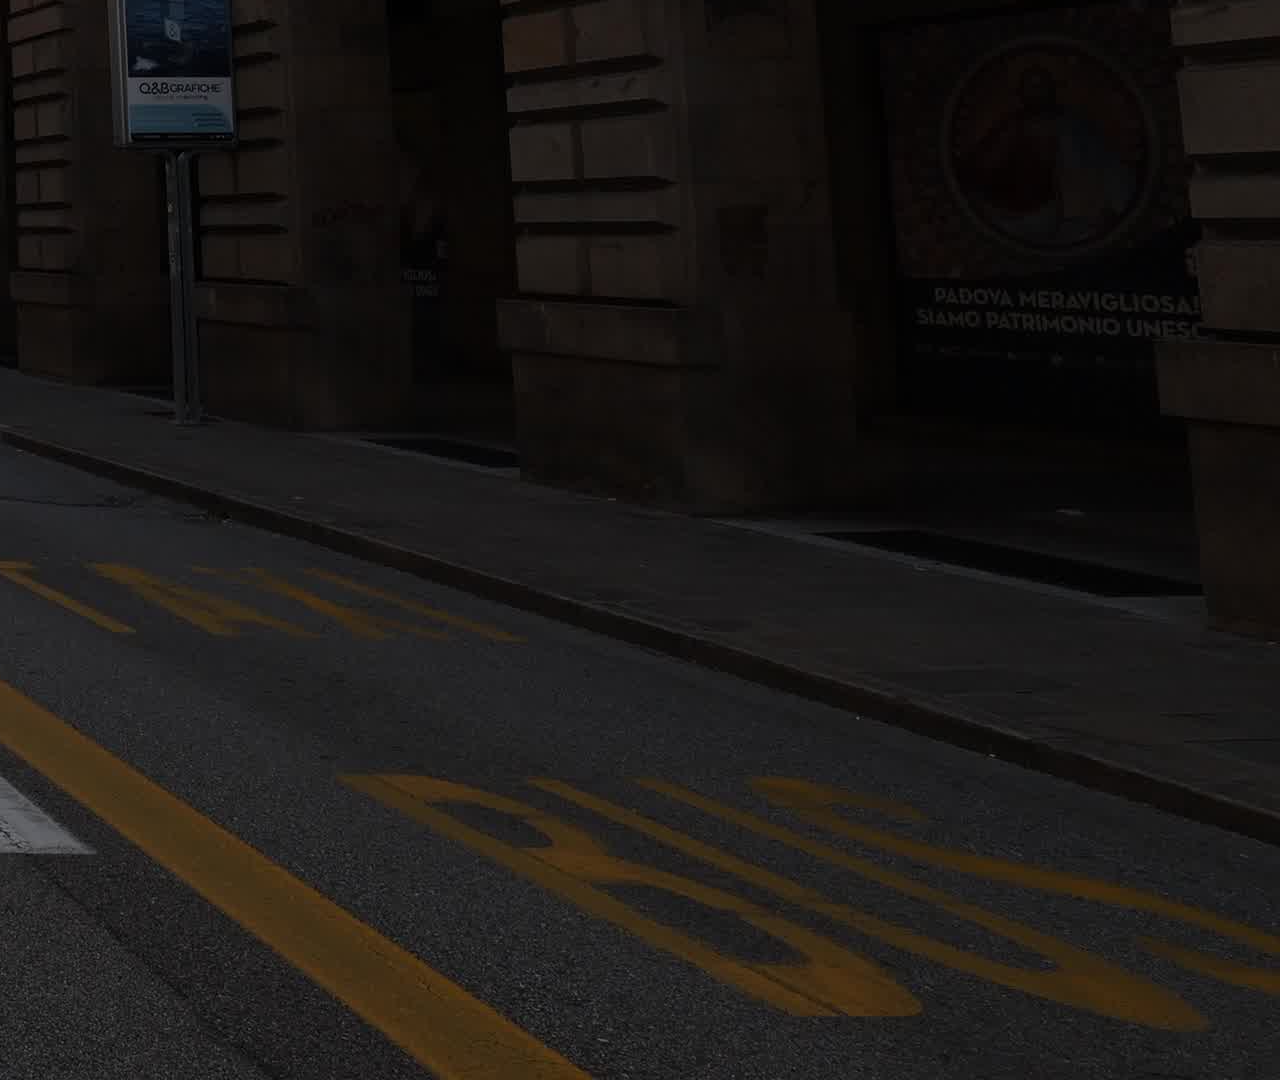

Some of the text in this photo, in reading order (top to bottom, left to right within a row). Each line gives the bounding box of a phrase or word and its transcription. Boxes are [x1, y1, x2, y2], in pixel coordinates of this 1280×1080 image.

[932, 287, 1201, 313] PADOVA MERAVIGLIOSA!
[913, 306, 1203, 338] SIAMO PATRIMONIO UNESC
[337, 772, 1280, 1032] BUS
